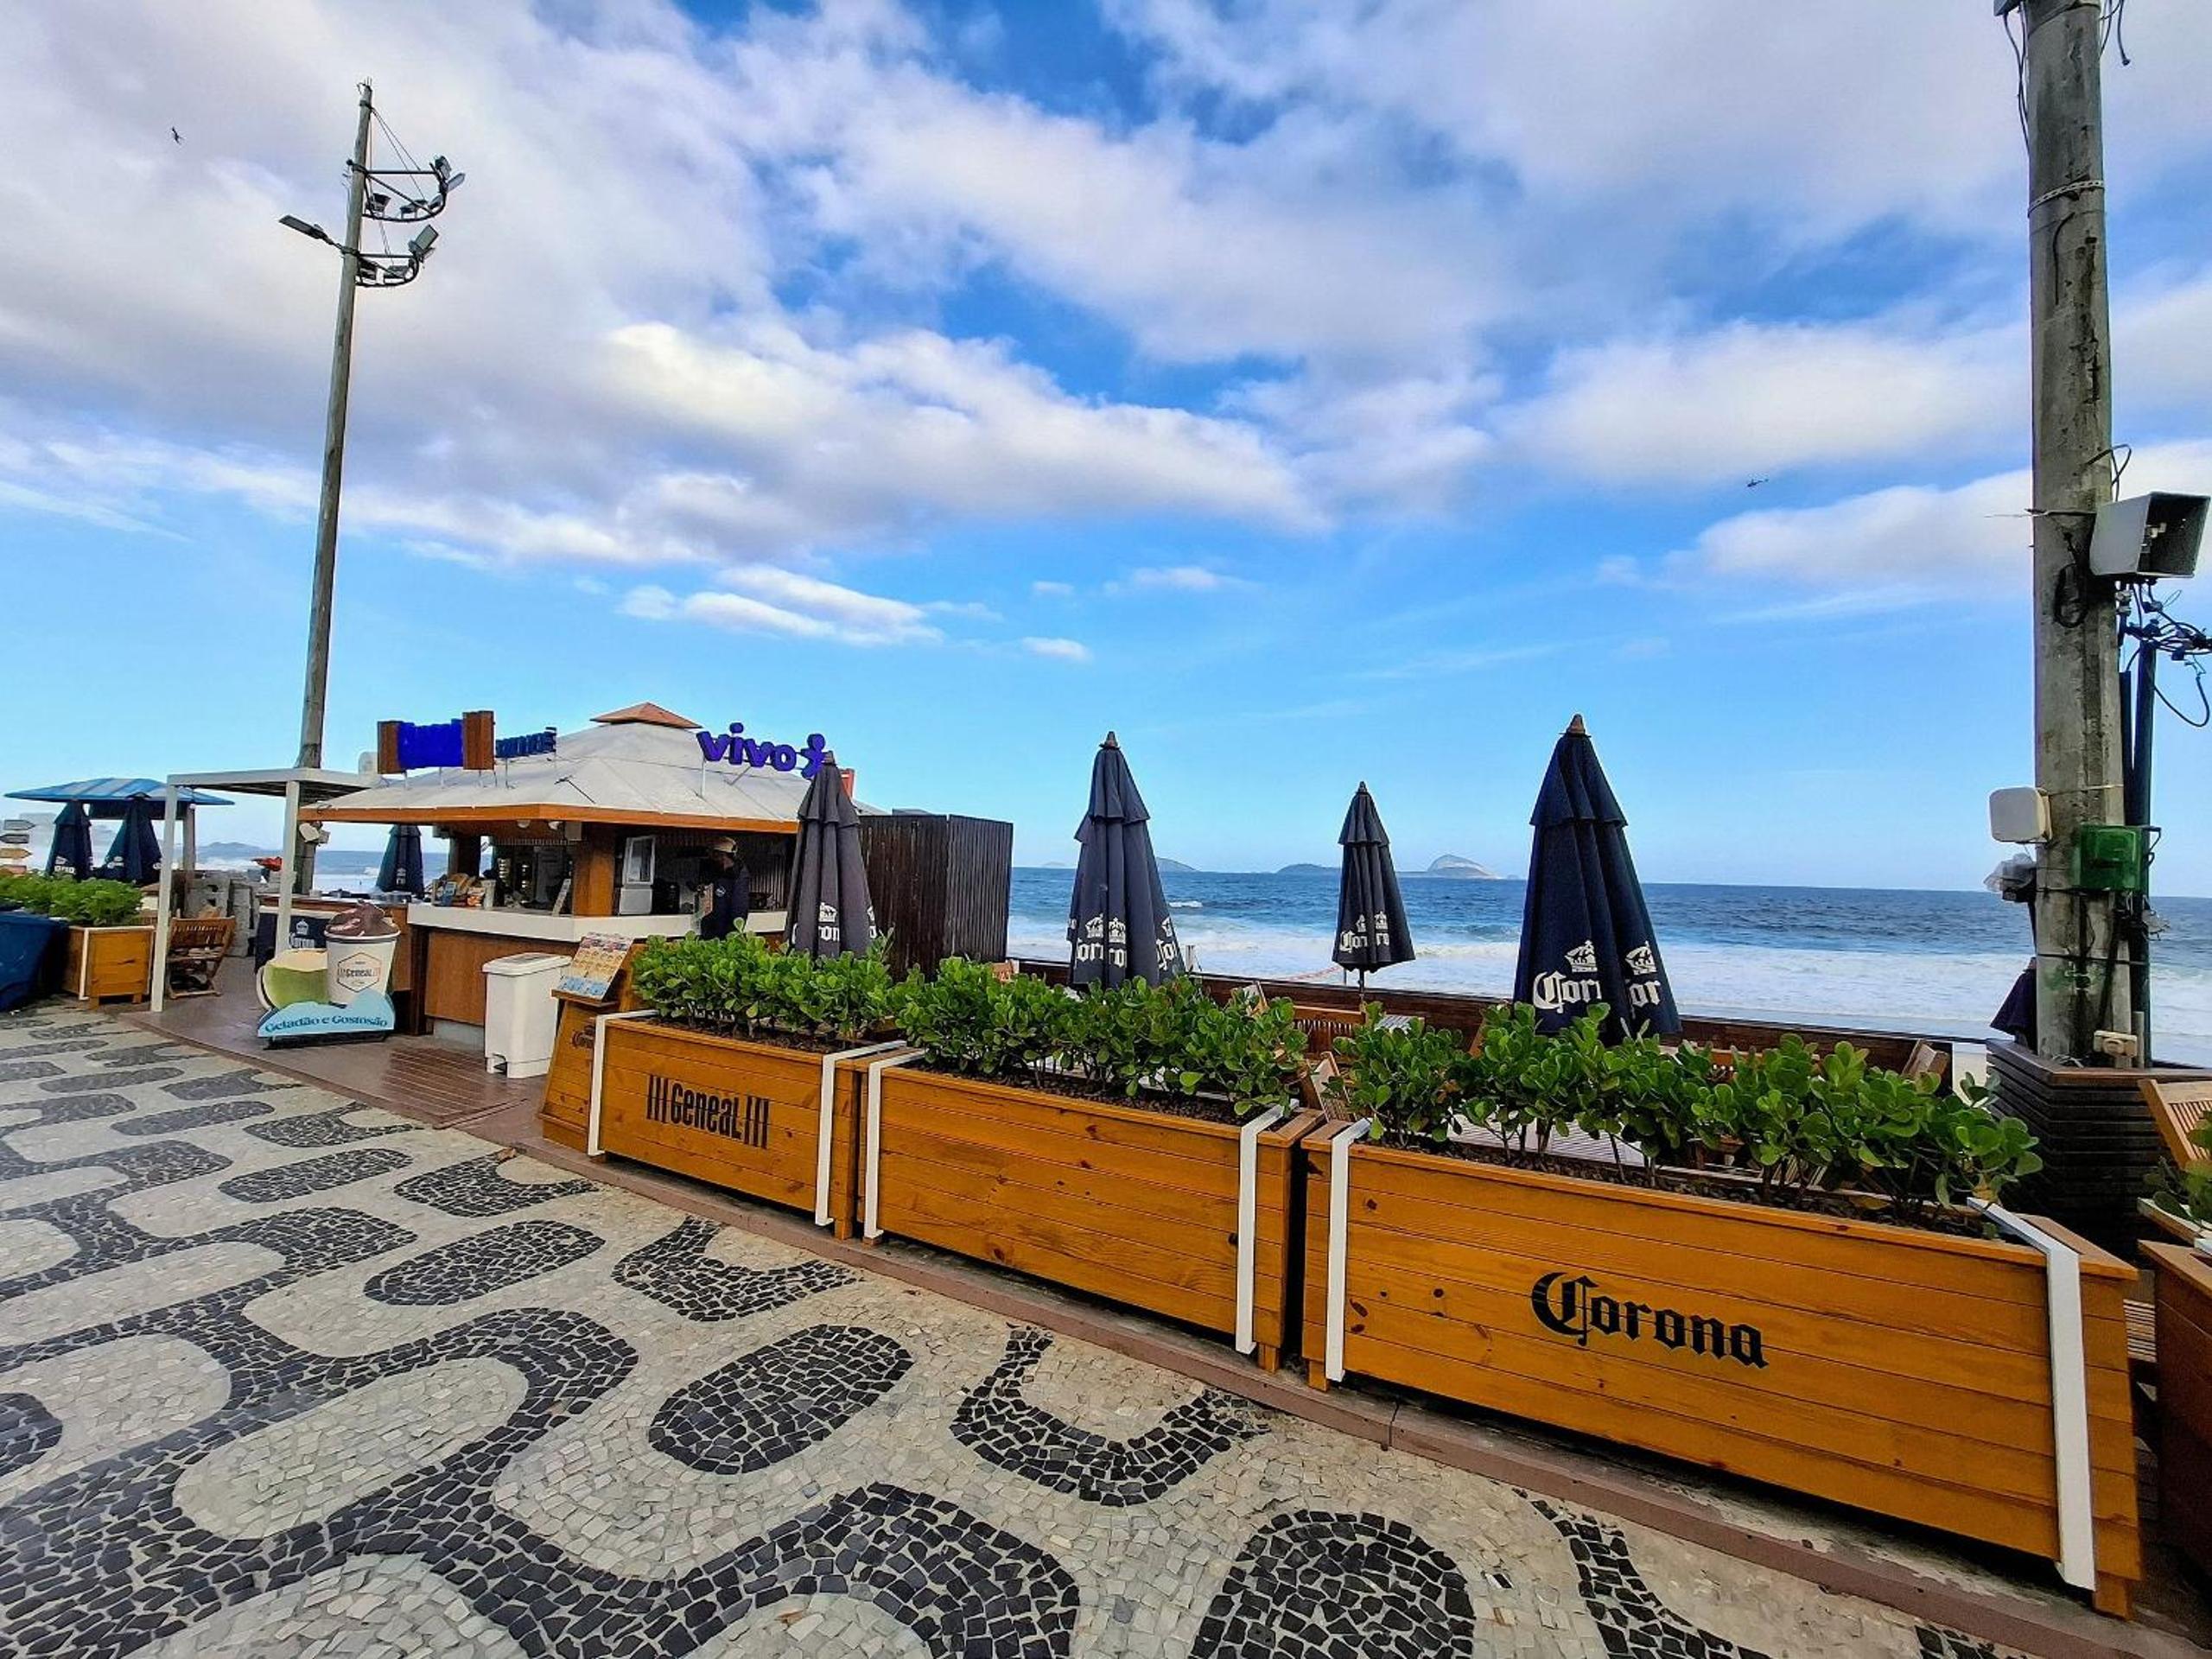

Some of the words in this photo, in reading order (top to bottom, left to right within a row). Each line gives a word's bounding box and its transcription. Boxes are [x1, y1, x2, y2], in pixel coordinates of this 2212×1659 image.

[696, 721, 797, 772] vivo
[264, 1015, 320, 1033] Geladão
[321, 1016, 330, 1025] e
[332, 1015, 388, 1027] Gostosão
[1530, 1271, 1770, 1370] Corona
